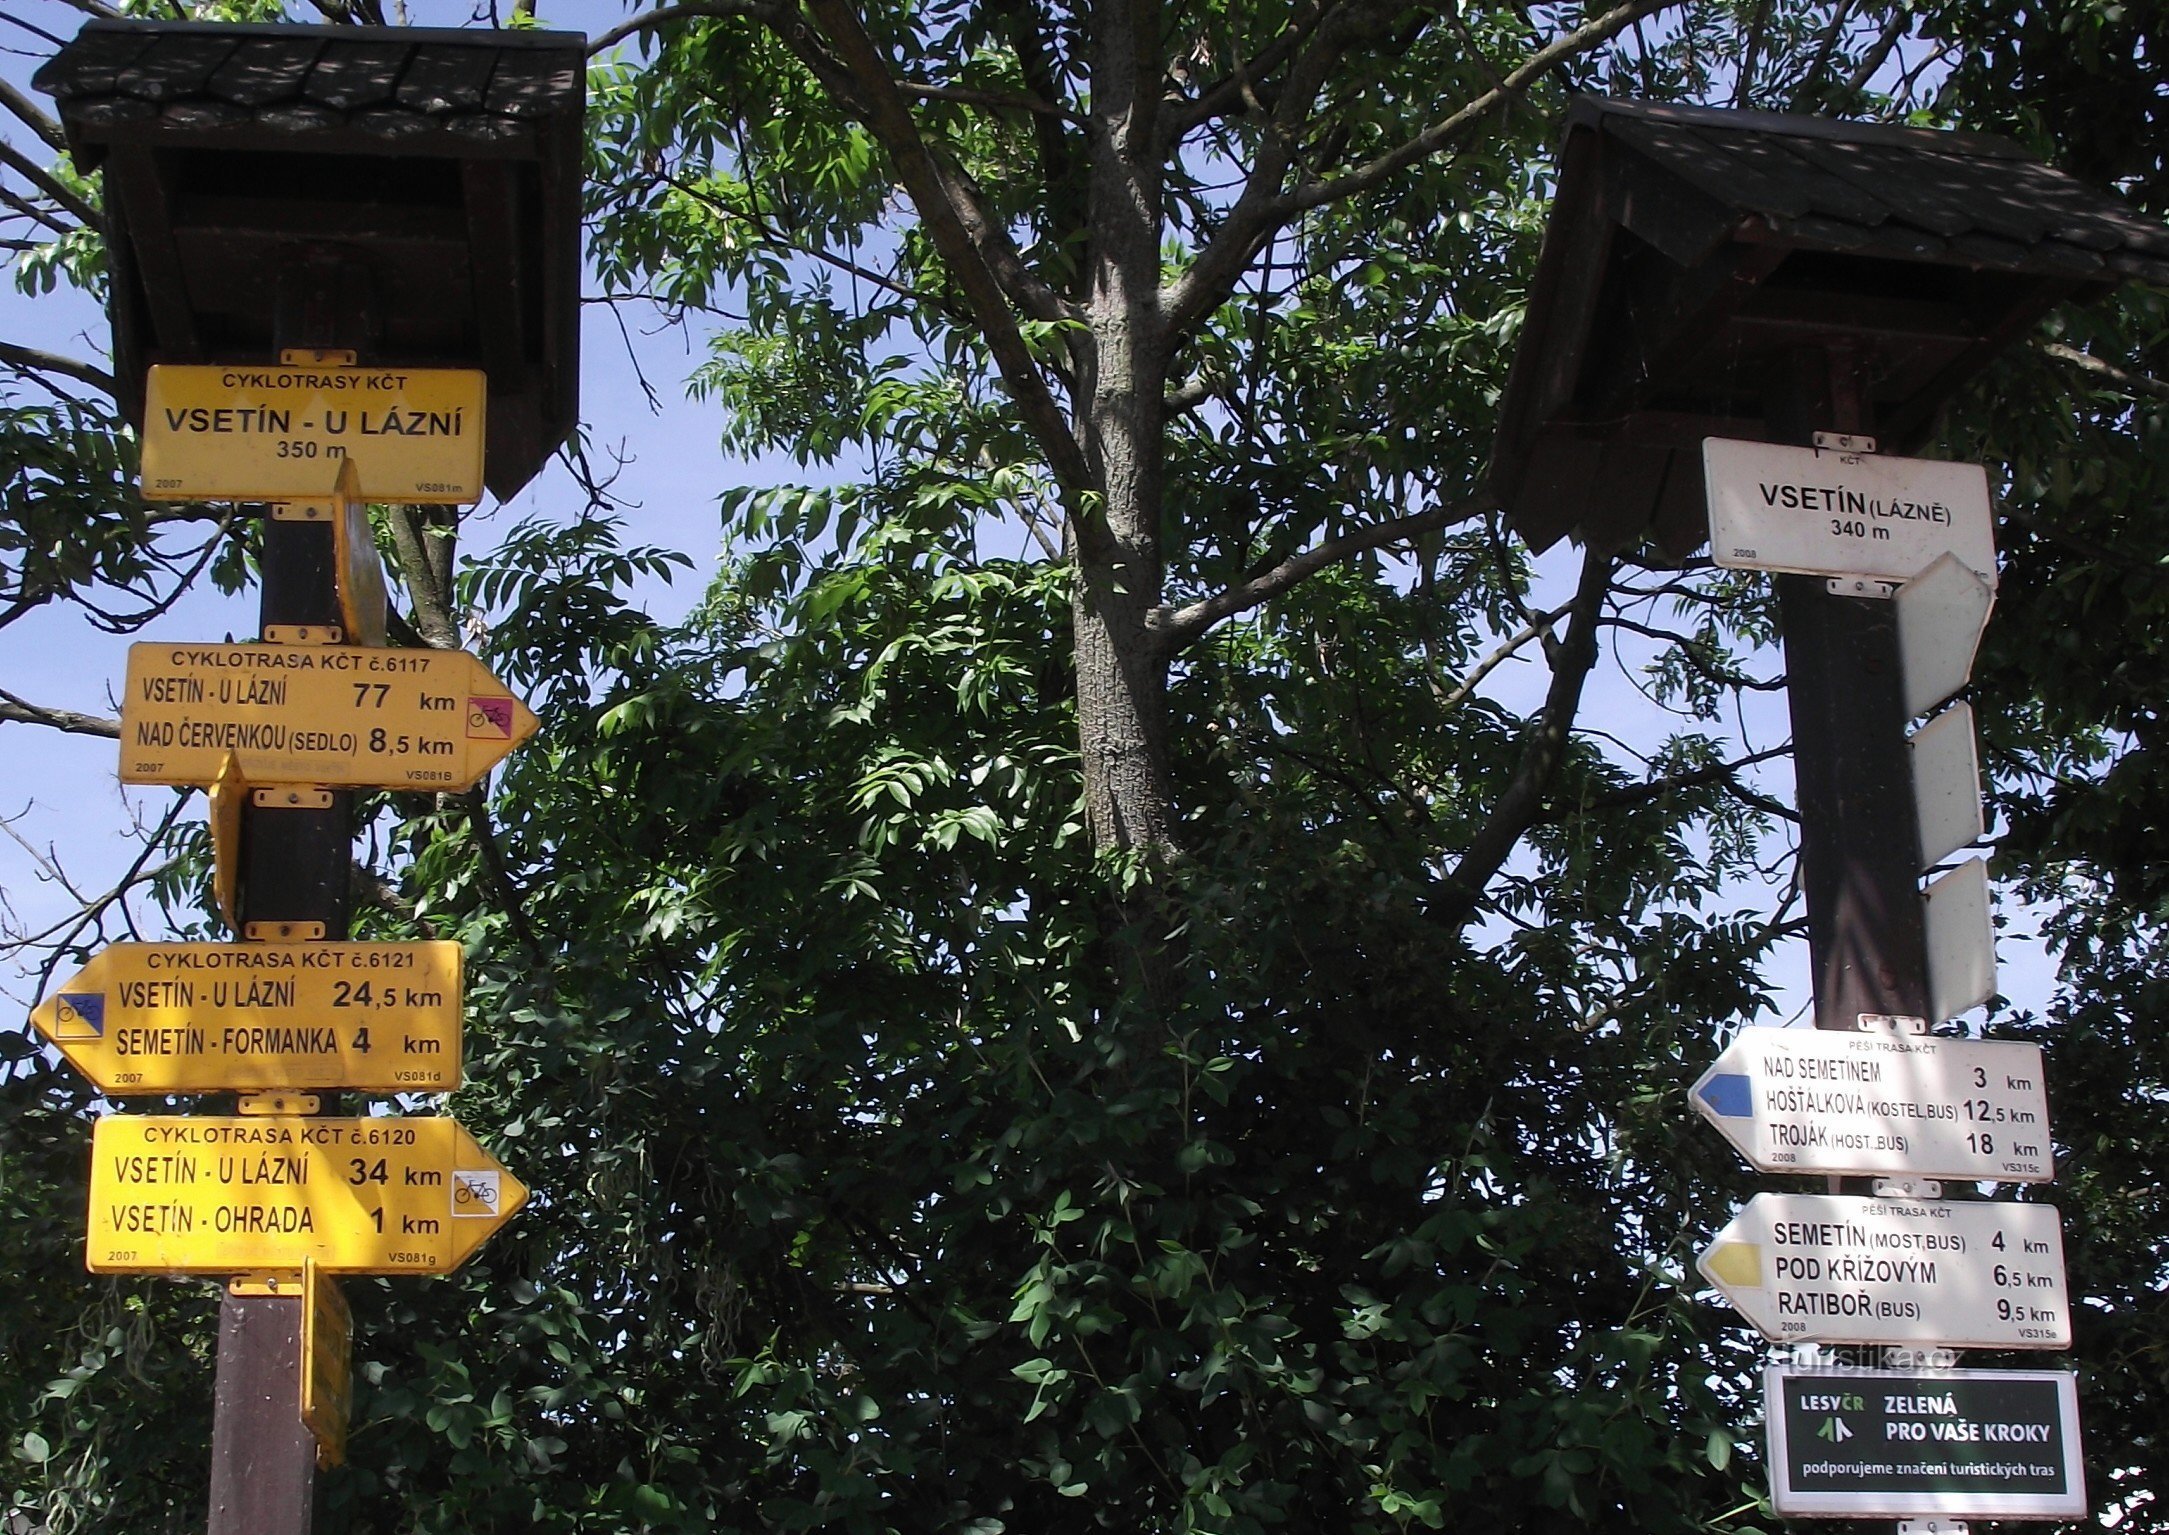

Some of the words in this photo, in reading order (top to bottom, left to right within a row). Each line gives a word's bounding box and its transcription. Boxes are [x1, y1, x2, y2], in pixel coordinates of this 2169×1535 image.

[222, 373, 361, 390] CYKLOTRASY
[366, 374, 407, 391] KČT
[165, 404, 290, 433] VSETÍN
[326, 411, 348, 435] U
[361, 407, 465, 437] LÁZNÍ
[277, 441, 318, 459] 350
[327, 445, 347, 459] m
[155, 479, 183, 489] 2007
[1759, 482, 1866, 516] VSETÍN
[1869, 498, 1952, 528] (LÁZNĚ)
[1831, 519, 1865, 538] 340
[1872, 526, 1890, 540] m
[1733, 548, 1757, 559] 2008
[172, 650, 315, 670] CYKLOTRASA
[321, 652, 362, 671] KČT
[369, 656, 430, 673] č.6117
[143, 673, 204, 704] VSETÍN
[220, 680, 234, 705] U
[238, 673, 287, 707] LÁZNÍ
[353, 682, 391, 708] 77
[419, 692, 456, 711] km
[137, 721, 175, 748] NAD
[178, 716, 286, 751] ČERVENKOU
[289, 730, 358, 757] (SEDLO)
[369, 728, 410, 756] 8,5
[418, 737, 455, 755] km
[136, 763, 164, 772] 2007
[148, 952, 296, 969] CYKLOTRASA
[302, 950, 344, 968] KČT
[351, 951, 415, 968] č.6121
[119, 975, 193, 1008] VSETÍN
[213, 981, 229, 1008] U
[235, 974, 296, 1008] LÁZNÍ
[332, 980, 397, 1010] 24,5
[405, 988, 443, 1007] km
[116, 1022, 205, 1056] SEMETÍN
[223, 1028, 338, 1055] FORMANKA
[352, 1027, 372, 1054] 4
[403, 1035, 441, 1054] km
[1876, 1042, 1912, 1053] TRASA
[1914, 1043, 1937, 1054] KČT
[115, 1073, 144, 1083] 2007
[394, 1072, 441, 1082] VS081d
[1763, 1056, 1794, 1078] NAD
[1799, 1056, 1882, 1083] SEMETÍNEM
[1974, 1067, 1986, 1089] 3
[2006, 1075, 2032, 1091] km
[1766, 1086, 1865, 1116] HOŠŤÁLKOVÁ
[1963, 1099, 2006, 1123] 12,5
[2010, 1108, 2035, 1124] km
[144, 1127, 293, 1144] CYKLOTRASA
[300, 1126, 343, 1145] KČT
[351, 1129, 415, 1146] č.6120
[1769, 1120, 1829, 1148] TROJÁK
[1966, 1132, 1994, 1155] 18
[2013, 1141, 2038, 1157] km
[115, 1150, 196, 1184] VSETÍN
[219, 1157, 233, 1185] U
[242, 1151, 309, 1185] LÁZNÍ
[348, 1158, 389, 1186] 34
[404, 1165, 442, 1186] km
[1772, 1152, 1796, 1163] 2008
[2002, 1162, 2040, 1173] VS315c
[112, 1199, 193, 1233] VSETÍN
[214, 1205, 315, 1234] OHRADA
[371, 1207, 384, 1234] 1
[402, 1214, 440, 1234] km
[1889, 1206, 1928, 1217] TRASA
[1930, 1206, 1953, 1218] KČT
[1774, 1219, 1866, 1247] SEMETÍN
[1991, 1230, 2006, 1252] 4
[2023, 1239, 2049, 1254] km
[108, 1251, 137, 1261] 2007
[388, 1252, 436, 1266] VS081g
[1776, 1257, 1820, 1280] POD
[1828, 1254, 1937, 1284] KŘÍŽOVÝM
[1993, 1264, 2022, 1287] 6,5
[2027, 1273, 2053, 1288] km
[1778, 1289, 1872, 1317] RATIBOŘ
[1875, 1300, 1921, 1321] (BUS)
[1997, 1299, 2025, 1323] 9,5
[2030, 1308, 2056, 1322] km
[1781, 1321, 1807, 1332] 2008
[1884, 1392, 1958, 1415] ZELENÁ
[1886, 1422, 1926, 1441] PRO
[1931, 1418, 1980, 1442] VAŠE
[1985, 1424, 2050, 1443] KROKY
[1802, 1460, 1893, 1479] podporujeme
[1897, 1461, 1947, 1475] značení
[1950, 1462, 2027, 1480] turistických
[2029, 1463, 2055, 1477] tras
